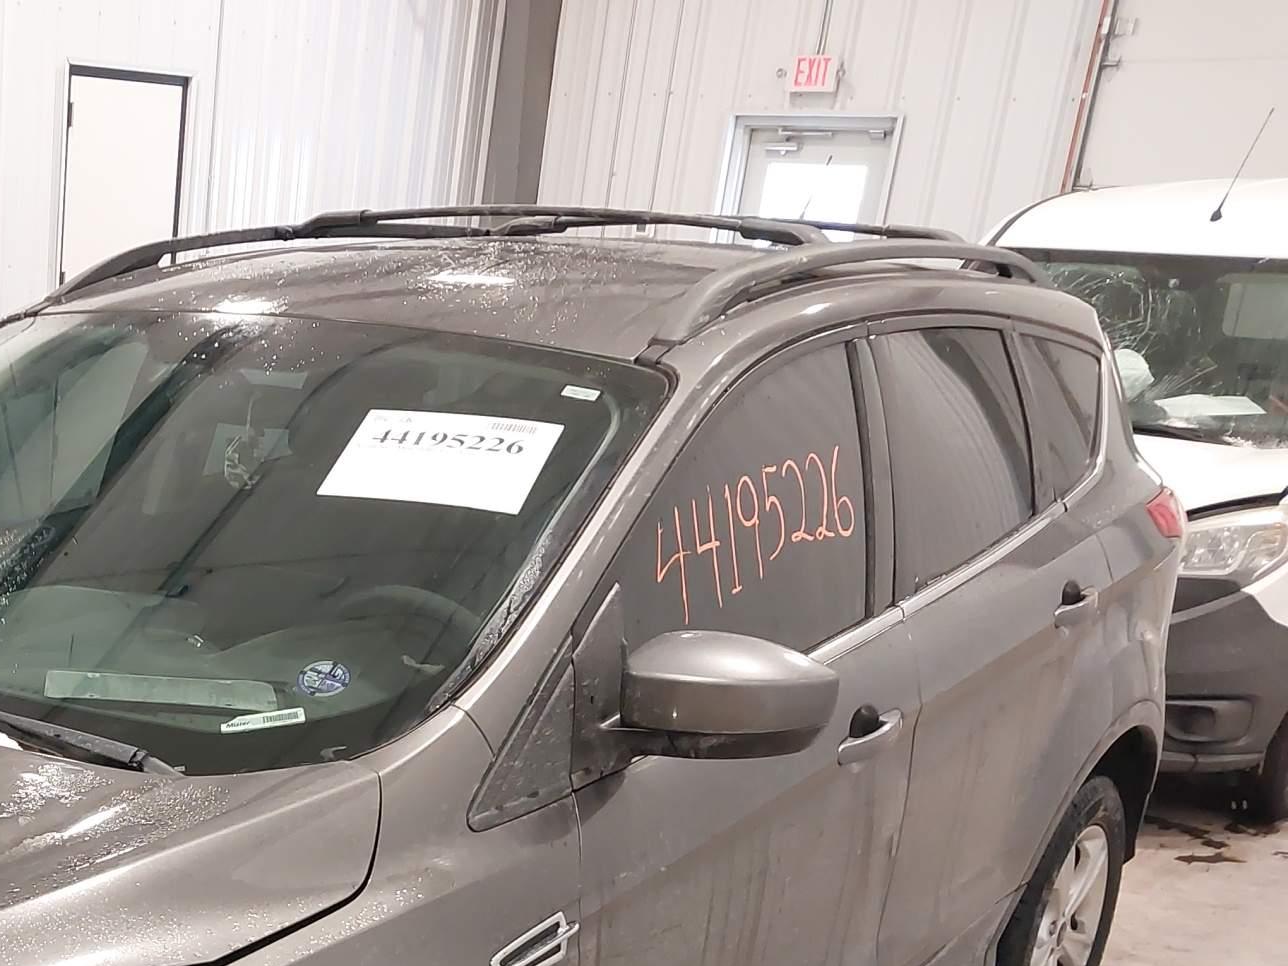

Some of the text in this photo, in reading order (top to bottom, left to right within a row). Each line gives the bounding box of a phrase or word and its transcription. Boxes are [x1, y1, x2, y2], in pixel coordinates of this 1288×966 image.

[794, 57, 832, 87] EXIT
[372, 428, 525, 455] 44195226
[656, 446, 855, 625] 44195226
